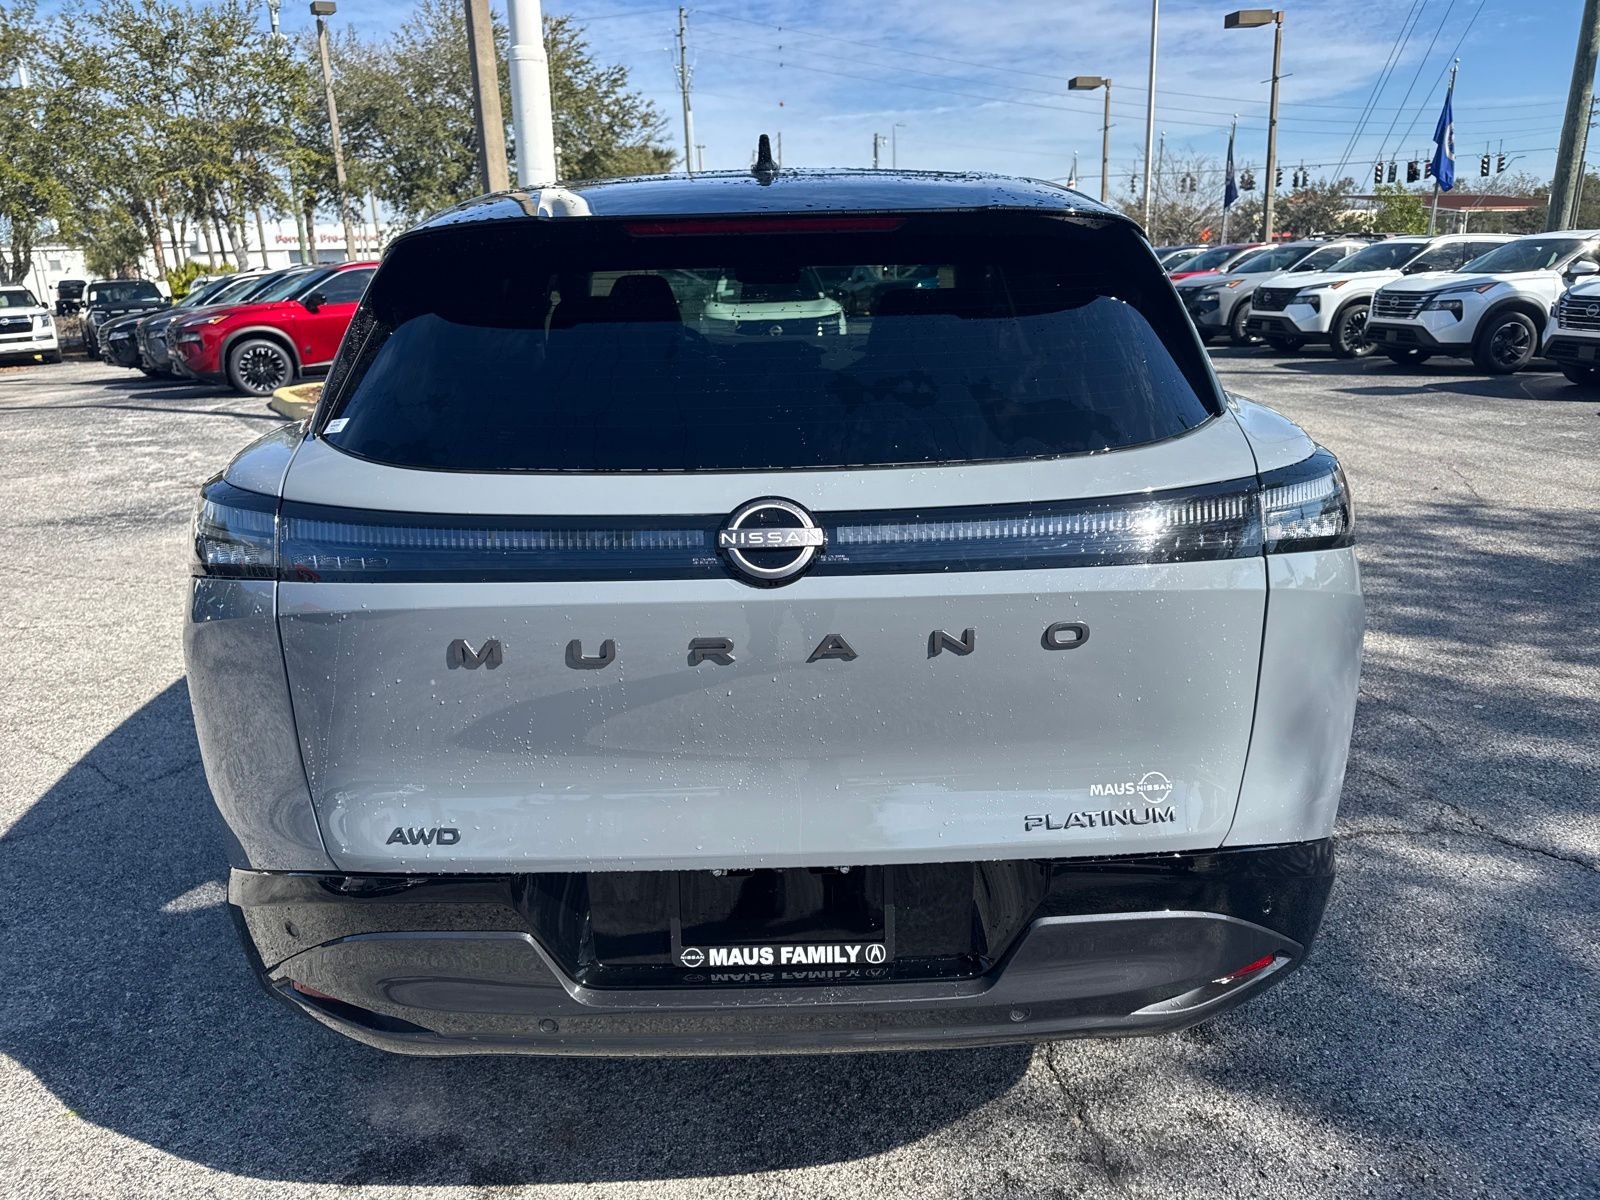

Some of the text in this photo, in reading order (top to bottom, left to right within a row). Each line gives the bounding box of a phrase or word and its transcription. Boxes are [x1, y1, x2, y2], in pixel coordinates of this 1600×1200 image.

[721, 531, 819, 545] NISSAN
[446, 620, 1090, 670] MURANO
[1090, 782, 1173, 797] MAUS NISSAN
[1024, 806, 1176, 832] PLATINUM
[385, 827, 461, 845] AWD
[709, 948, 774, 966] MAUS
[781, 945, 862, 964] FAMILY
